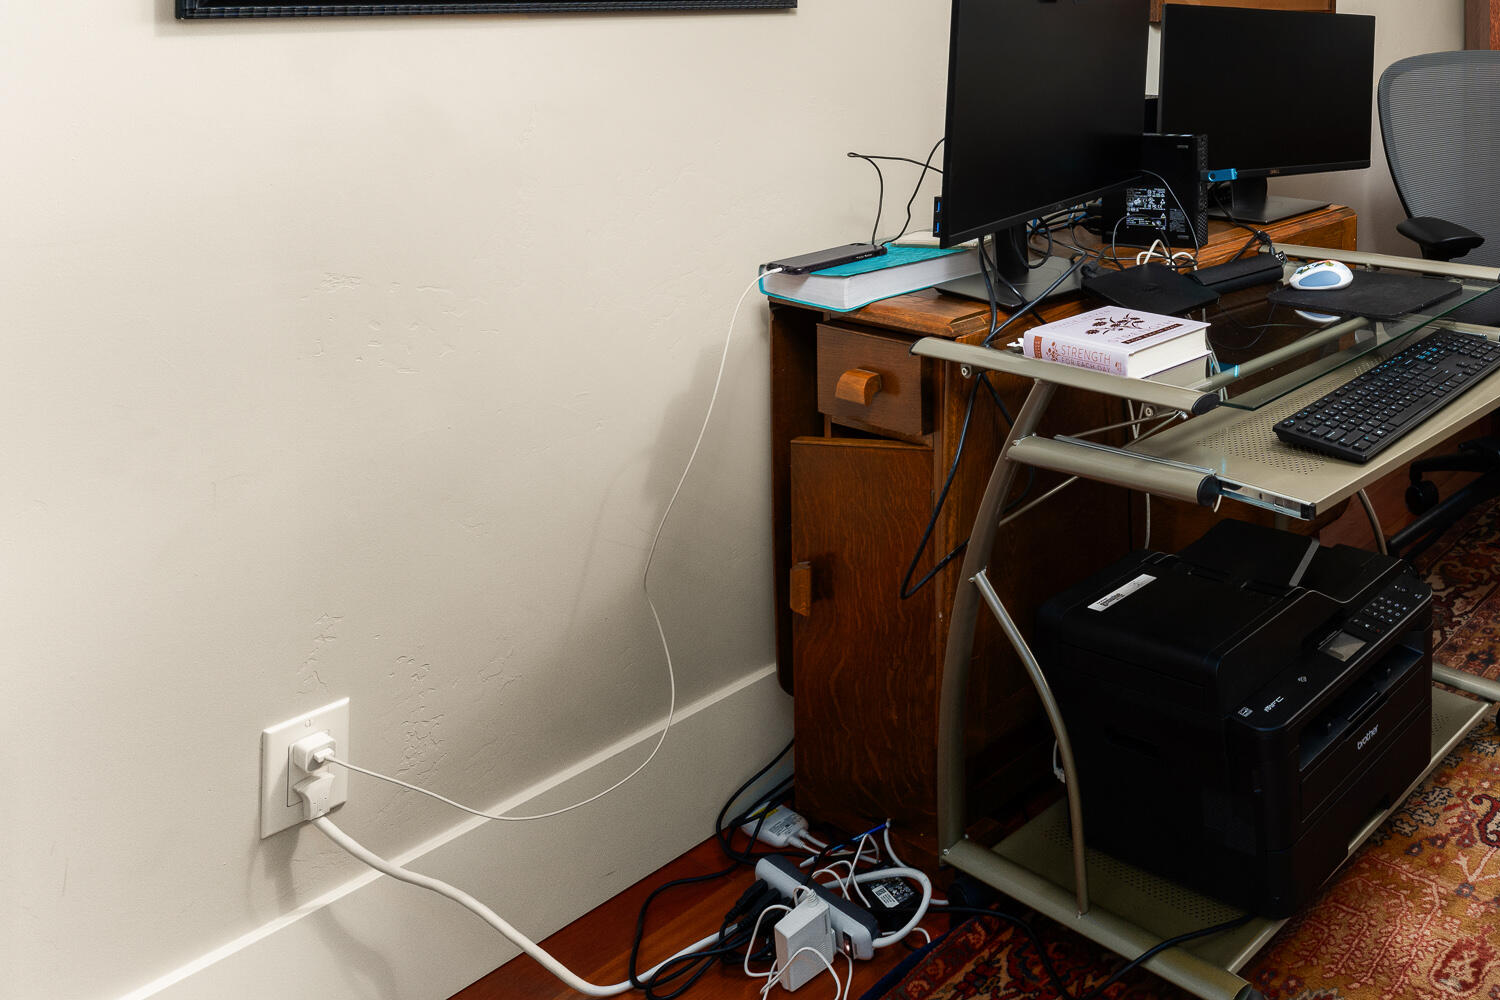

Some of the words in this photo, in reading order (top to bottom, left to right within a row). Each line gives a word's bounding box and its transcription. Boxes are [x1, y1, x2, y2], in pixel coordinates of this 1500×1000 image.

[1060, 344, 1111, 365] STRENGTH
[1061, 356, 1073, 365] FOR
[1074, 359, 1096, 369] EACH
[1097, 365, 1111, 373] DAY
[1357, 724, 1379, 751] brother
